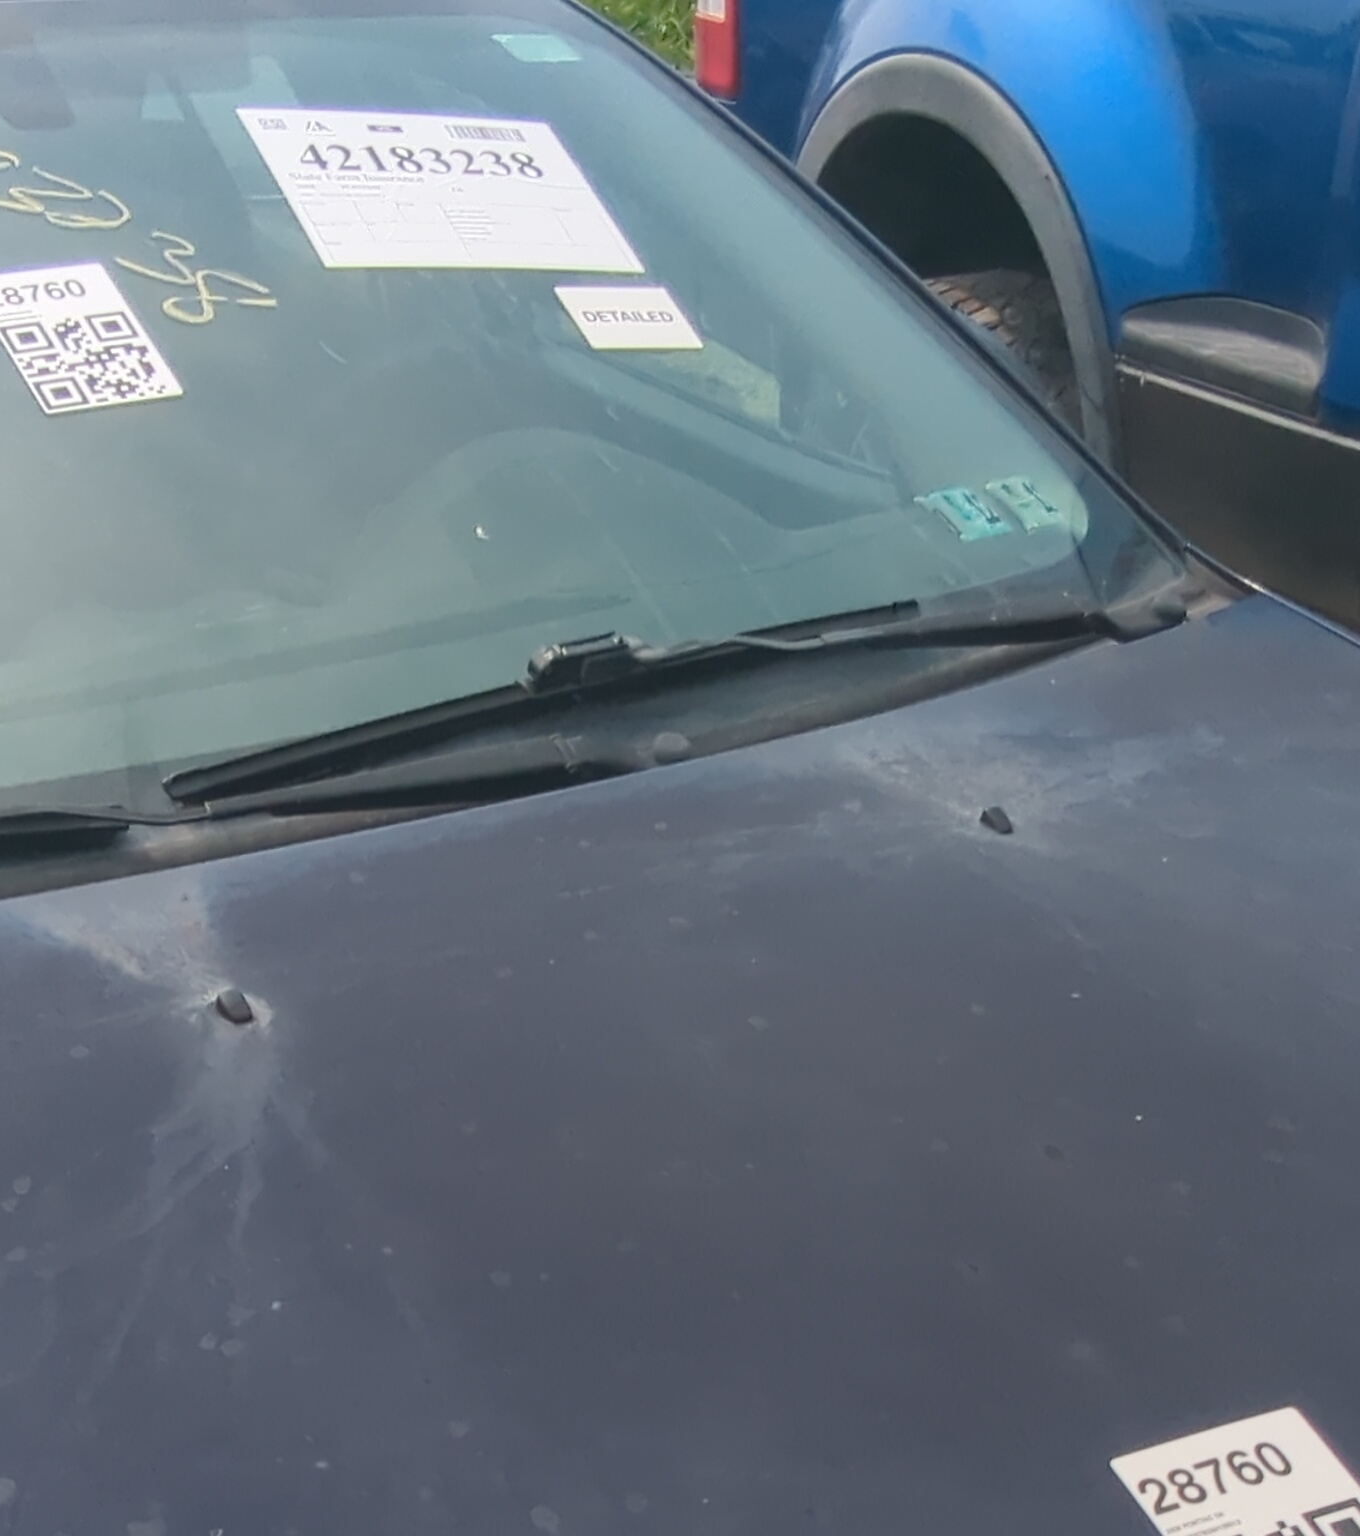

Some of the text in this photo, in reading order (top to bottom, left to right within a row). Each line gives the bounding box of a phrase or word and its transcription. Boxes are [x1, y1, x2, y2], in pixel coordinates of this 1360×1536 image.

[299, 143, 544, 179] 42183238
[581, 310, 674, 323] DETAILED
[1137, 1440, 1293, 1516] 28760
